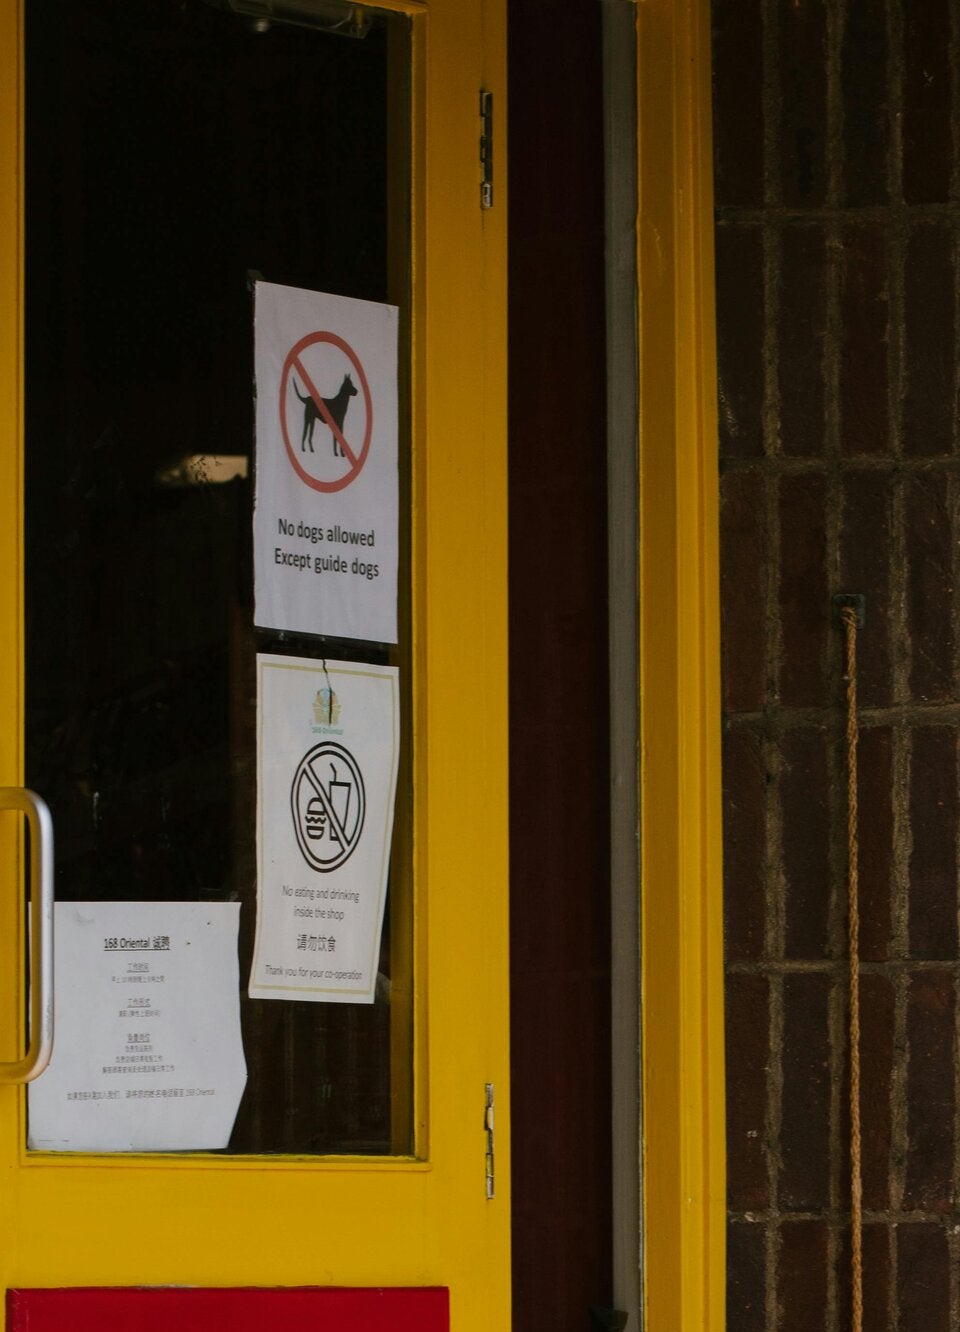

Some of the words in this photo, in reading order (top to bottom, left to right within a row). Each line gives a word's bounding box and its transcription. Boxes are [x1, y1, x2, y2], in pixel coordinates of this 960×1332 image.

[278, 518, 295, 536] No
[297, 521, 324, 544] dogs
[326, 525, 375, 547] allowed
[274, 547, 312, 572] Except
[314, 554, 348, 574] guide
[351, 558, 380, 580] dogs
[282, 885, 294, 897] No
[295, 887, 315, 901] eating
[316, 887, 329, 899] and
[330, 887, 360, 904] drinking
[293, 905, 313, 918] inside
[314, 906, 326, 919] the
[327, 908, 345, 922] shop
[103, 937, 119, 949] 168
[119, 936, 151, 949] Oriental
[265, 964, 283, 976] Thank
[284, 968, 297, 979] you
[298, 966, 309, 977] for
[309, 969, 324, 980] your
